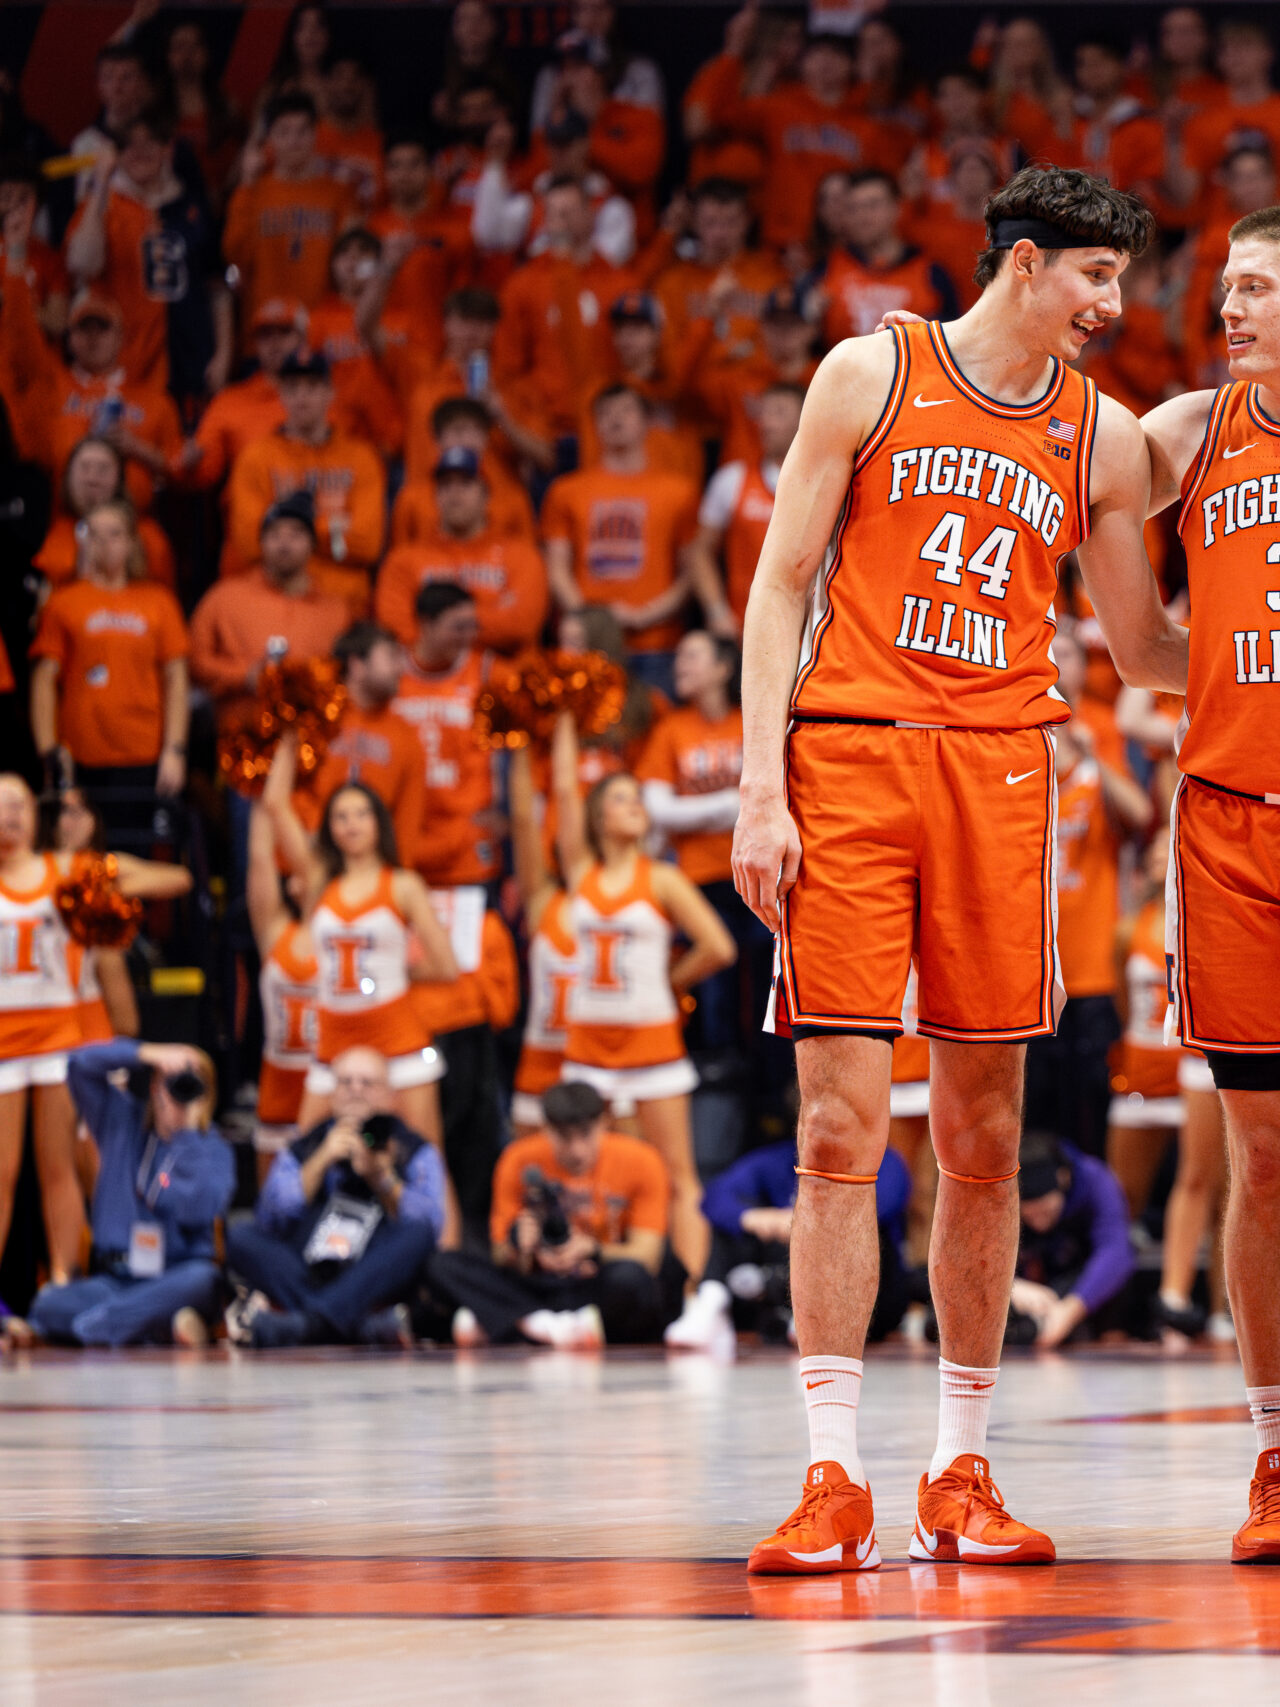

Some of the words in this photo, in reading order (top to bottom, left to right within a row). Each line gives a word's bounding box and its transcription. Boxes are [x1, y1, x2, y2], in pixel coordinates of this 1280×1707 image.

[888, 446, 1065, 547] FIGHTING
[919, 511, 1018, 600] 44
[894, 593, 1008, 670] ILLINI
